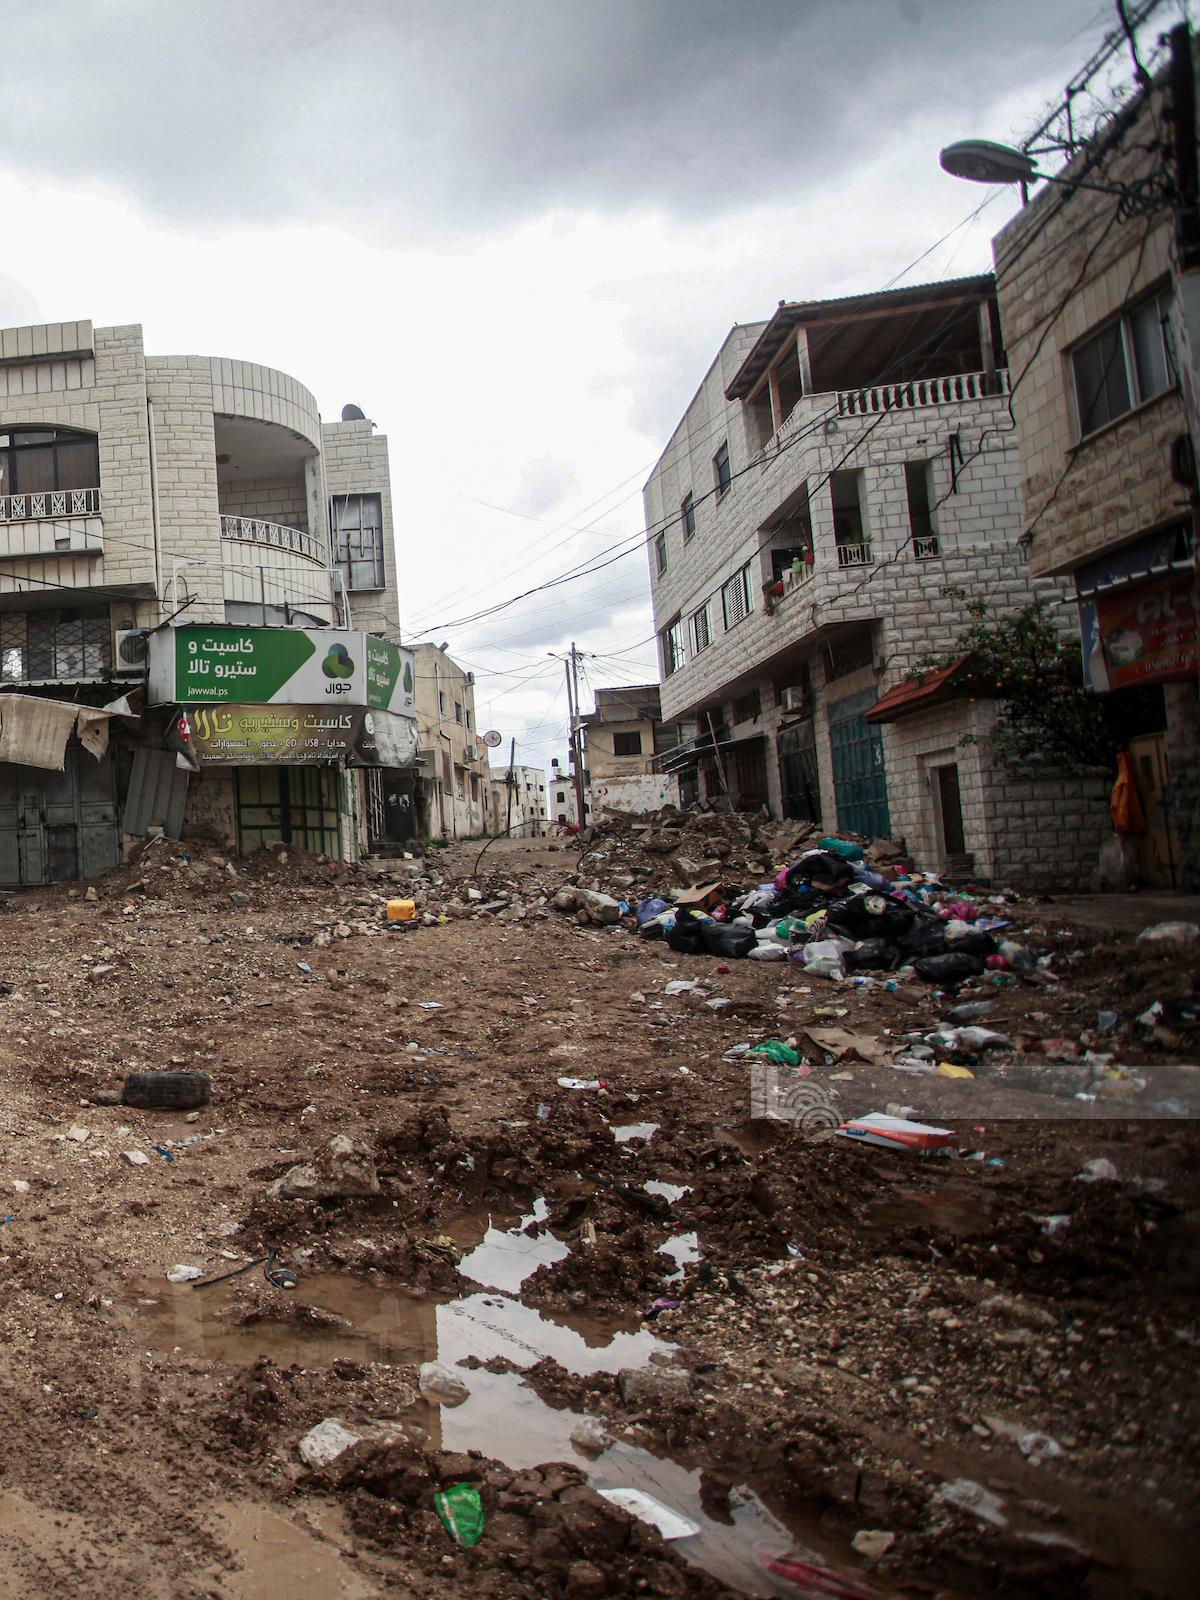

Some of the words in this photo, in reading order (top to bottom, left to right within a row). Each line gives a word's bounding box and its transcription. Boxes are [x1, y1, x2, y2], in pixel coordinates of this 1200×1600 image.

[187, 640, 198, 654] و
[202, 638, 254, 656] كاسيت
[367, 649, 372, 661] و
[371, 649, 389, 665] كاسيت
[187, 659, 211, 674] تالا
[214, 661, 257, 678] ستيرو
[187, 686, 229, 697] jawwal.ps
[325, 683, 352, 695] جوال
[193, 708, 234, 741] تالا
[303, 714, 353, 733] كاسيت
[285, 738, 297, 748] CD
[304, 738, 320, 748] USB
[326, 739, 347, 750] هدايا
